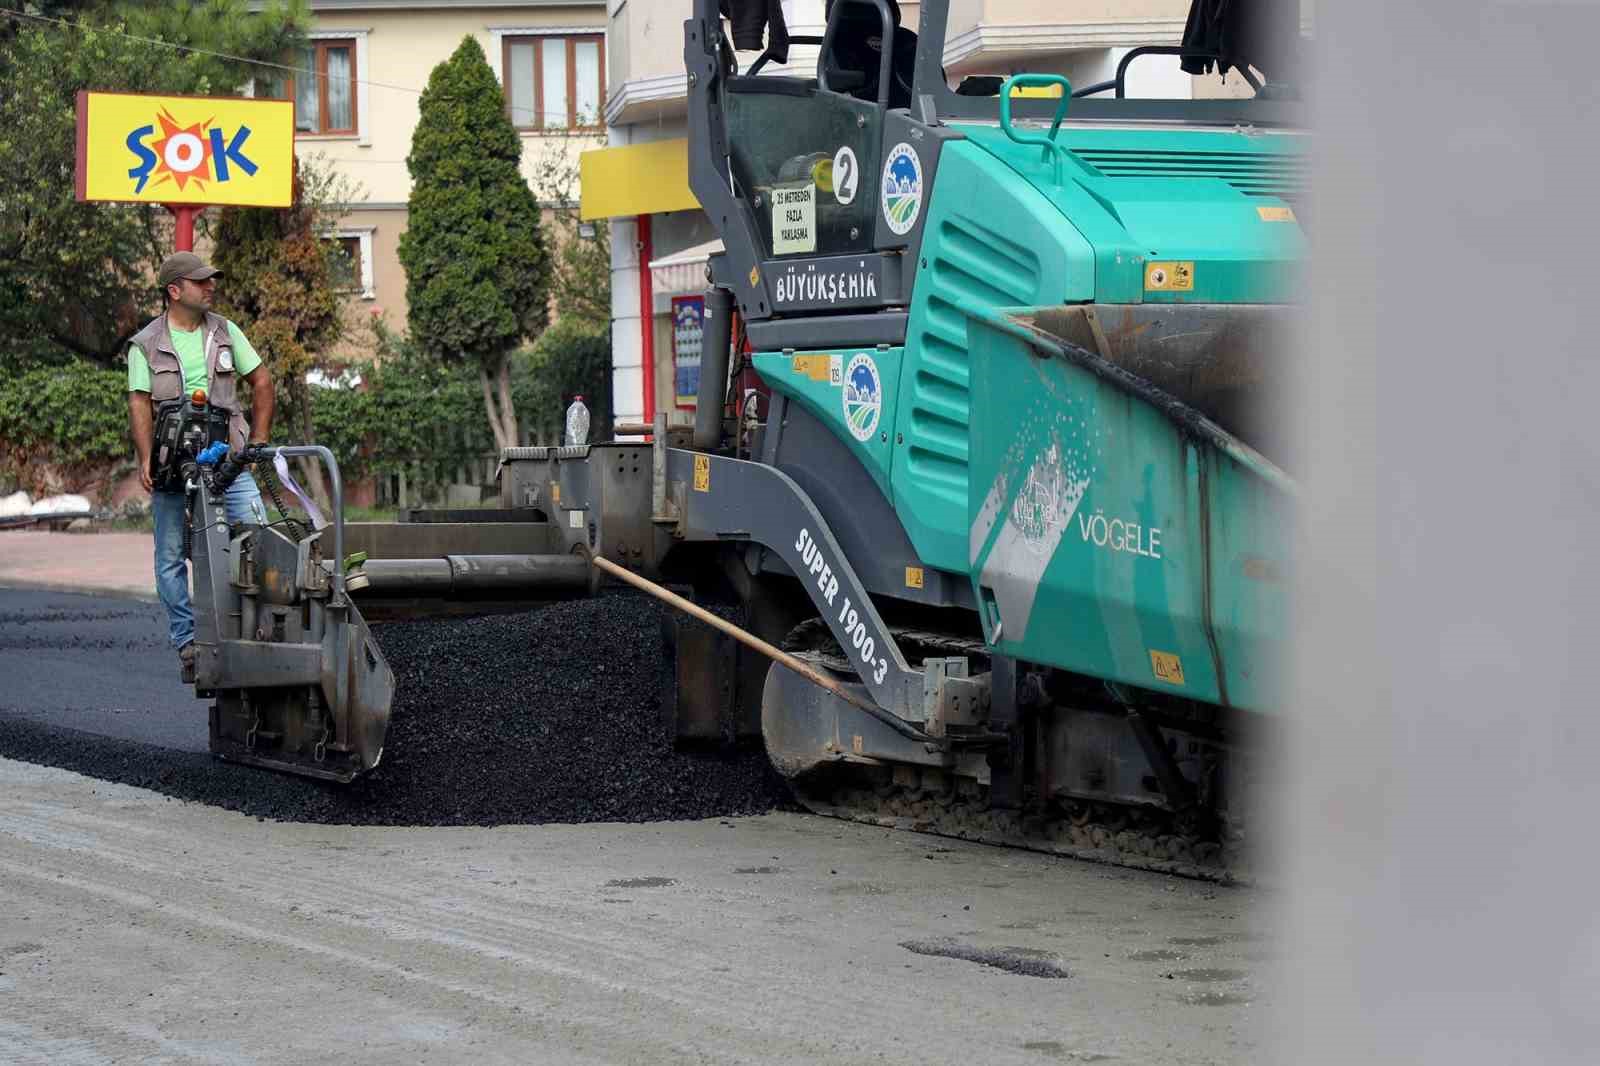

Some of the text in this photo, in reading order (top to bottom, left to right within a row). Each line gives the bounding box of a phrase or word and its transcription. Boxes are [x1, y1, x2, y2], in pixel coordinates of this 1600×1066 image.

[126, 124, 259, 195] ŞOK
[838, 153, 852, 198] 2
[785, 189, 811, 203] METREDEN
[786, 209, 803, 223] FAZLA
[776, 260, 877, 303] BÜYÜKŞEHİR
[1079, 508, 1161, 559] VÖGELE
[795, 528, 888, 685] SUPER 1900-3
